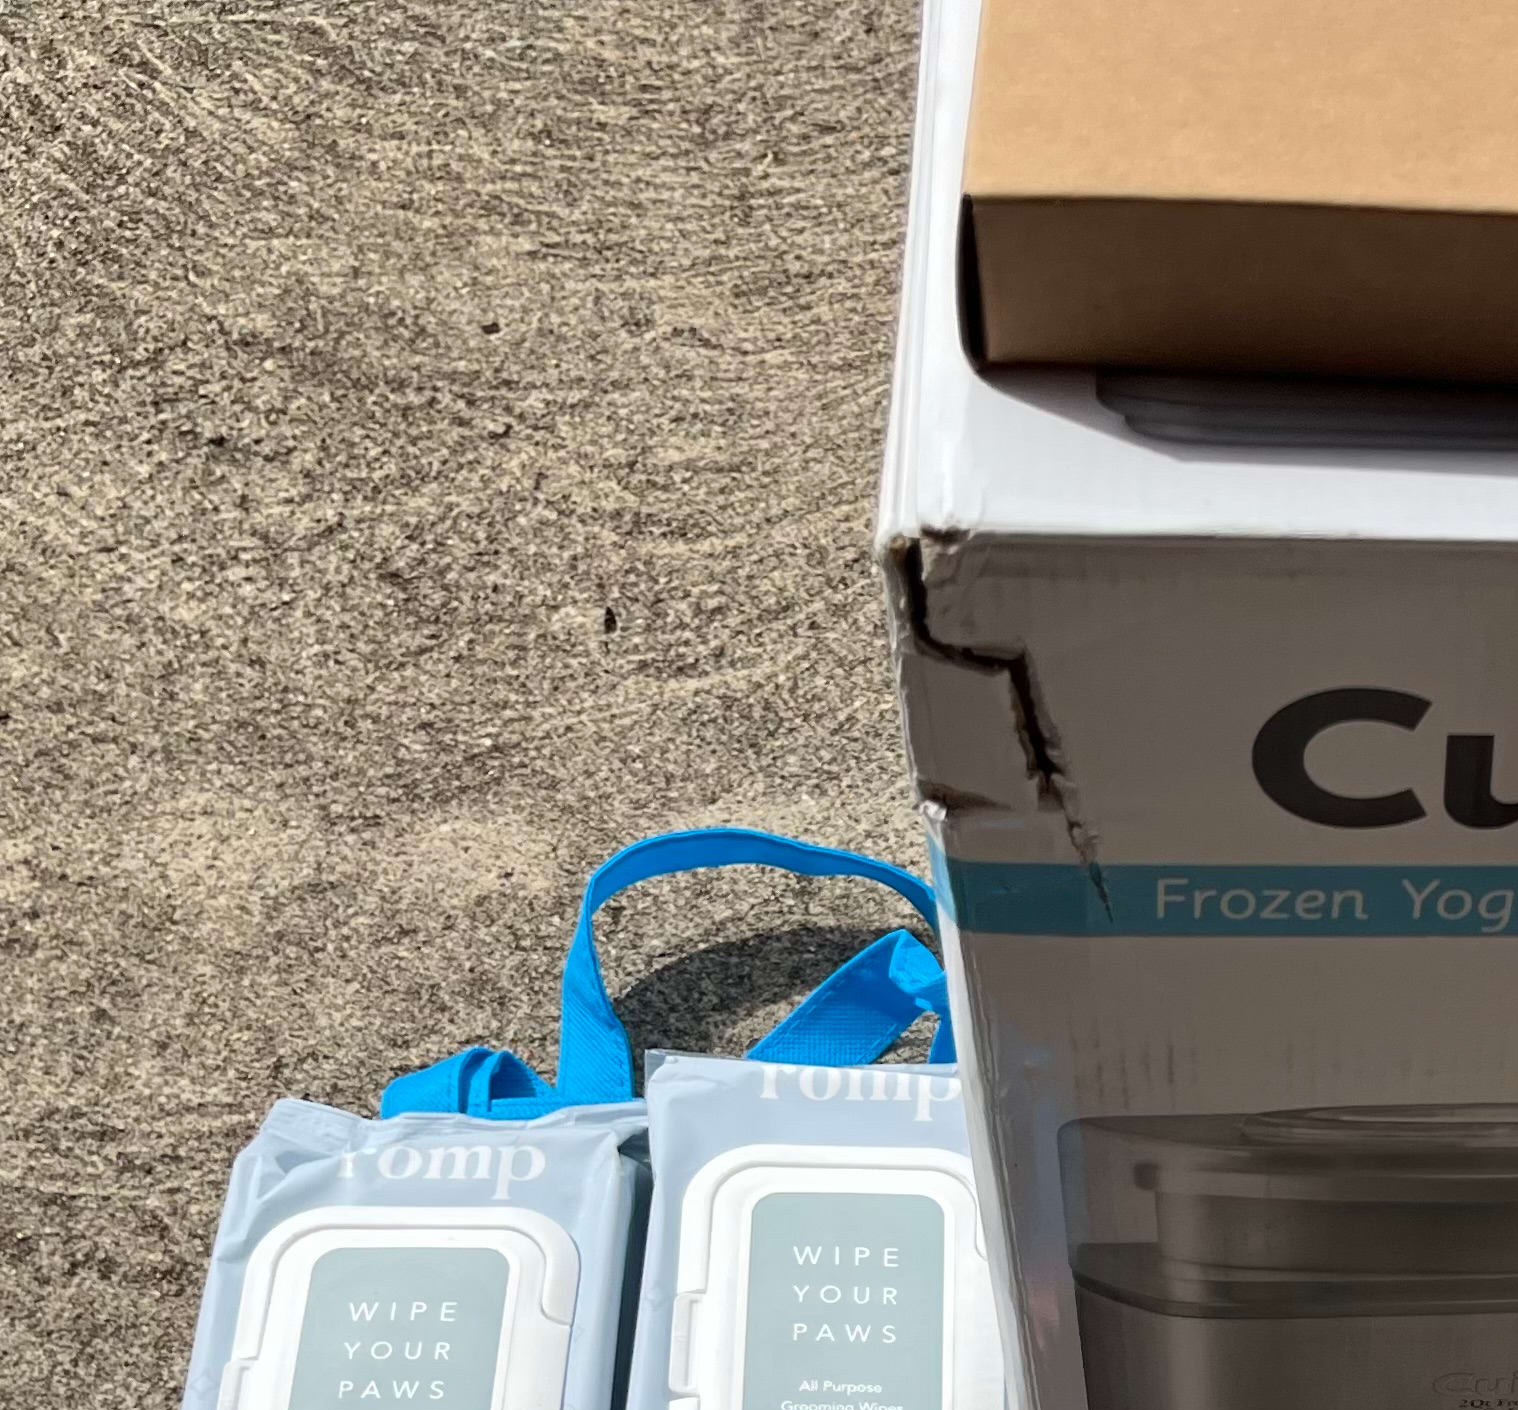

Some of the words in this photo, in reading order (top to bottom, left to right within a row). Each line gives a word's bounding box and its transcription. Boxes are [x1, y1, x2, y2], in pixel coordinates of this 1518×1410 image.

[1155, 876, 1369, 921] Frozen
[336, 1139, 547, 1200] romp
[792, 1245, 900, 1268] WIPE
[791, 1284, 898, 1306] YOUR
[348, 1301, 459, 1322] WIPE
[792, 1322, 898, 1344] PAWS
[343, 1340, 452, 1361] YOUR
[337, 1379, 446, 1400] PAWS
[799, 1379, 819, 1392] All
[822, 1379, 884, 1396] Purpose
